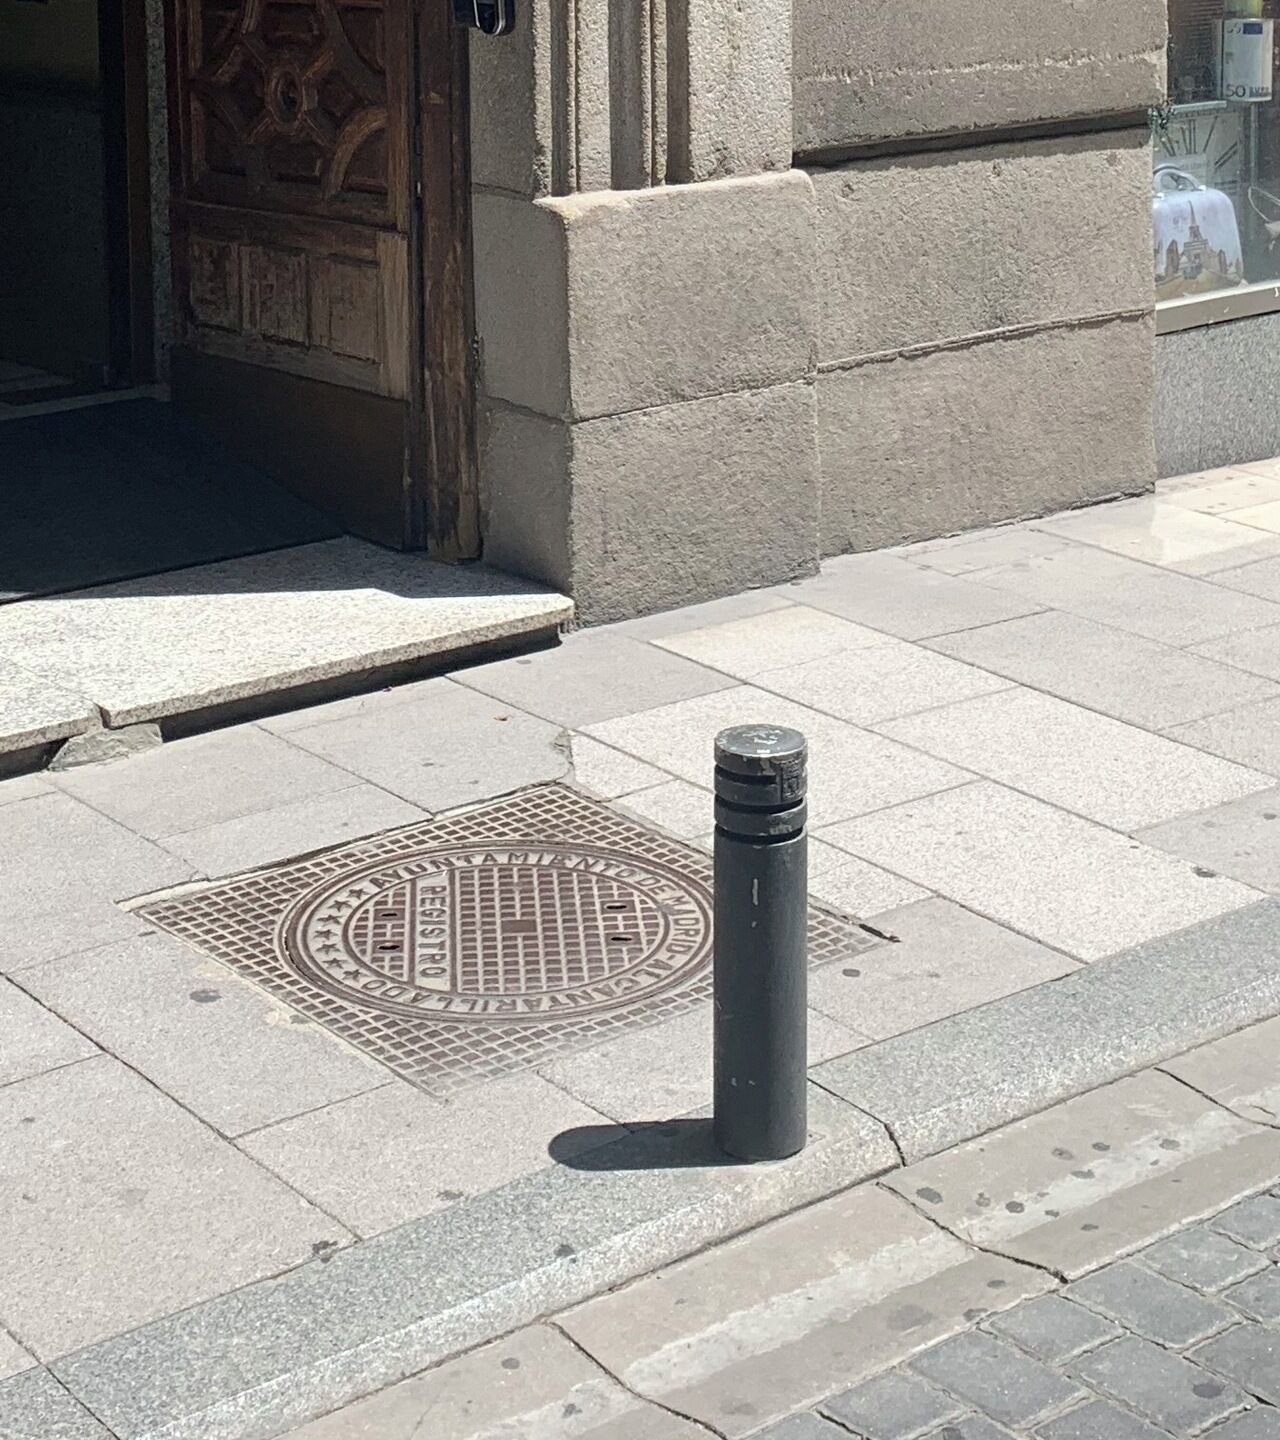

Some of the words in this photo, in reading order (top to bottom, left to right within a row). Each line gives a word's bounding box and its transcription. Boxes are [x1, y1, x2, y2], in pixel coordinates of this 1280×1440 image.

[1226, 84, 1246, 98] 50
[369, 851, 638, 890] AYUNTAMIENTO
[635, 876, 677, 897] DE
[419, 885, 448, 979] REGISTRO
